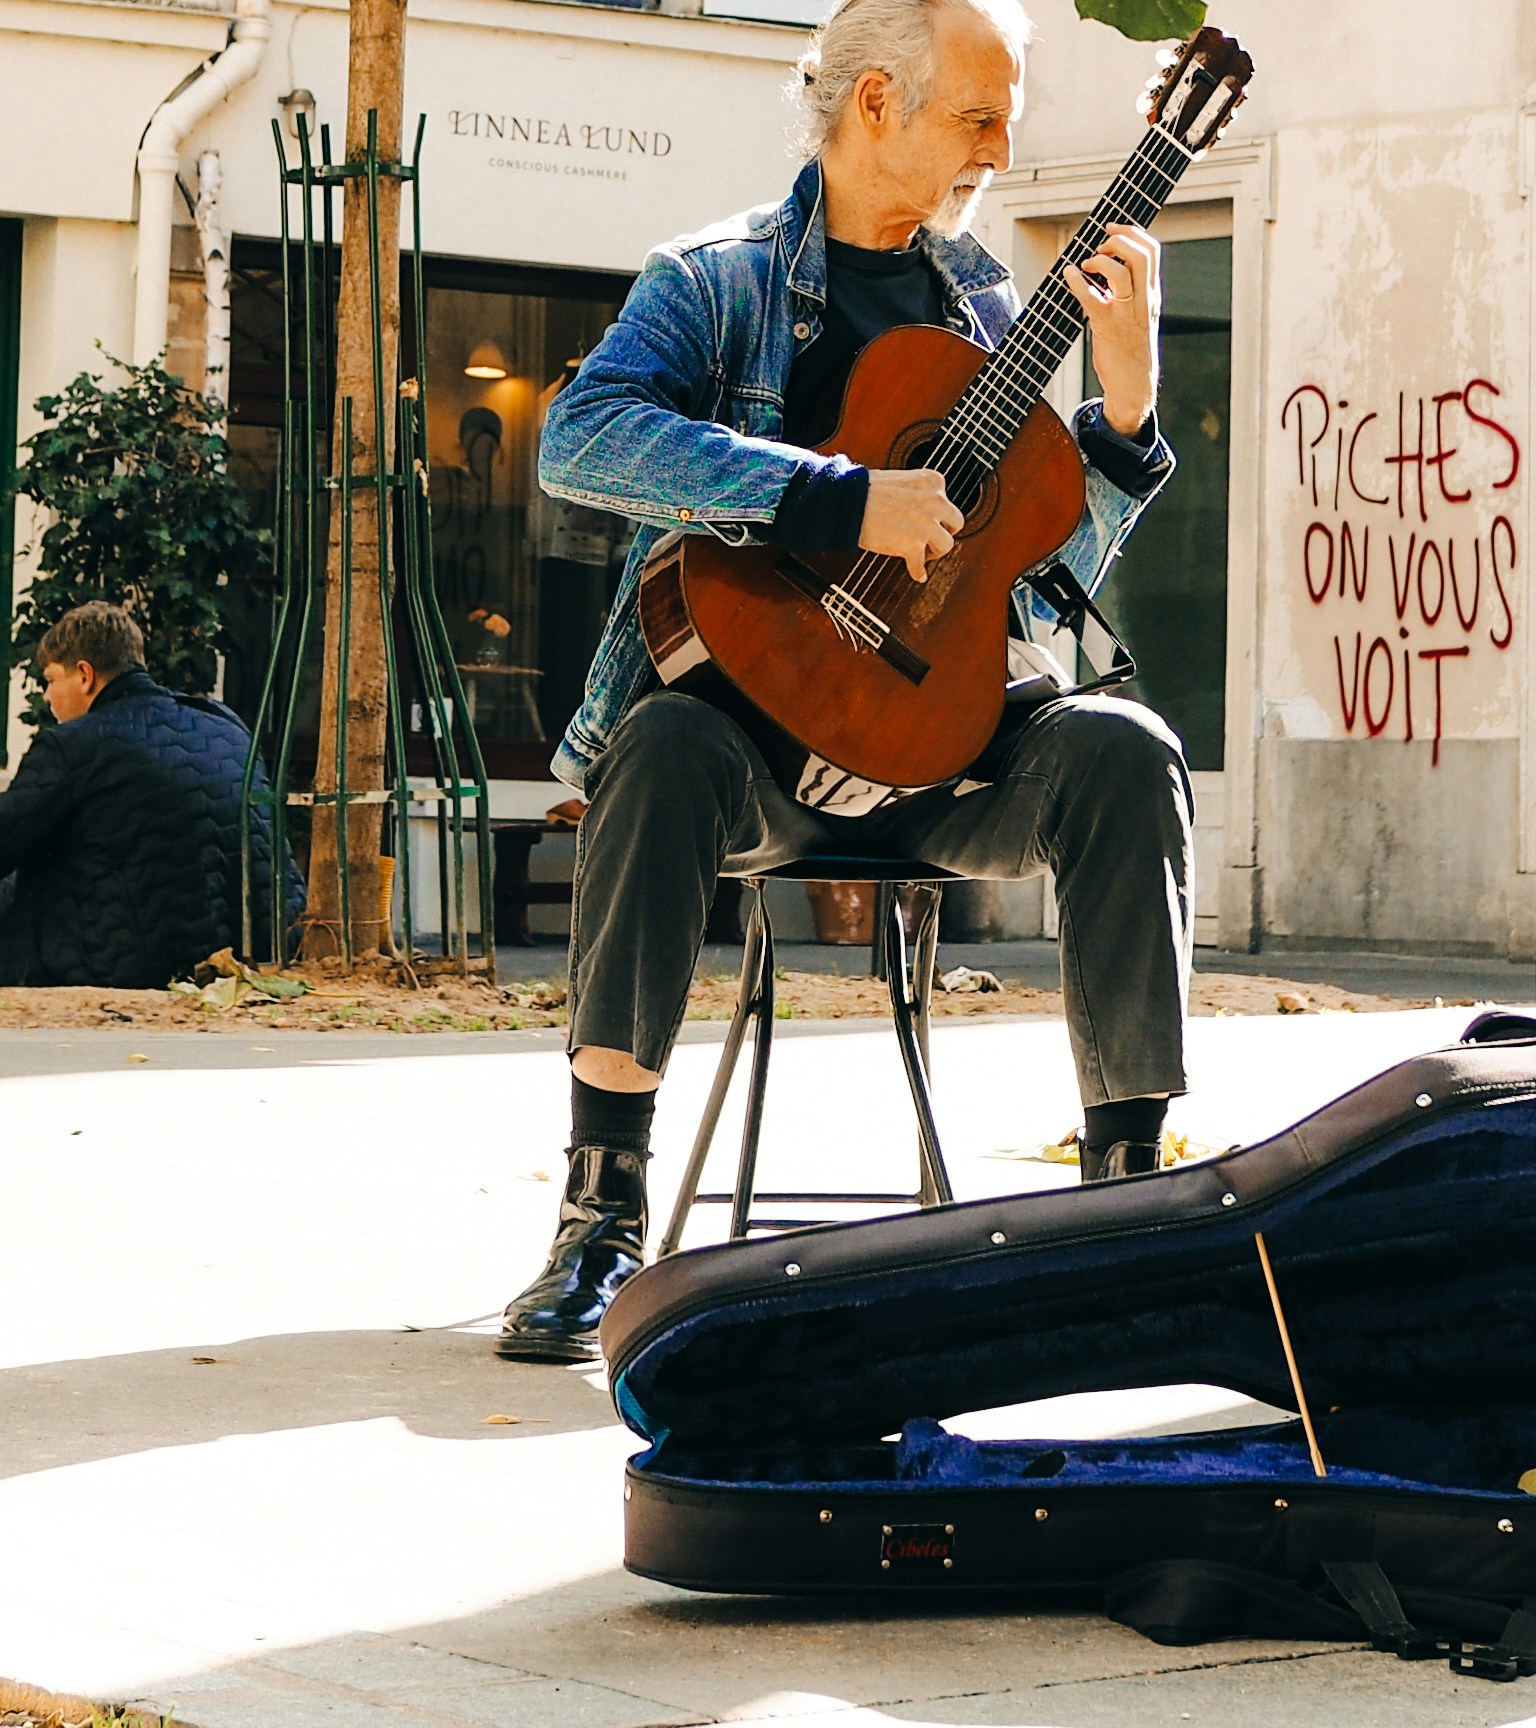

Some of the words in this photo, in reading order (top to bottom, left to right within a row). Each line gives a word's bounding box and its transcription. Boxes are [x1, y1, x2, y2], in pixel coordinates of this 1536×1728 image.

[448, 110, 572, 147] LINNEA
[580, 125, 672, 158] LUND
[488, 156, 559, 175] CONSCIOUS
[563, 165, 628, 181] CASHMERE
[1304, 520, 1369, 604] ON
[1388, 515, 1516, 650] VOUS
